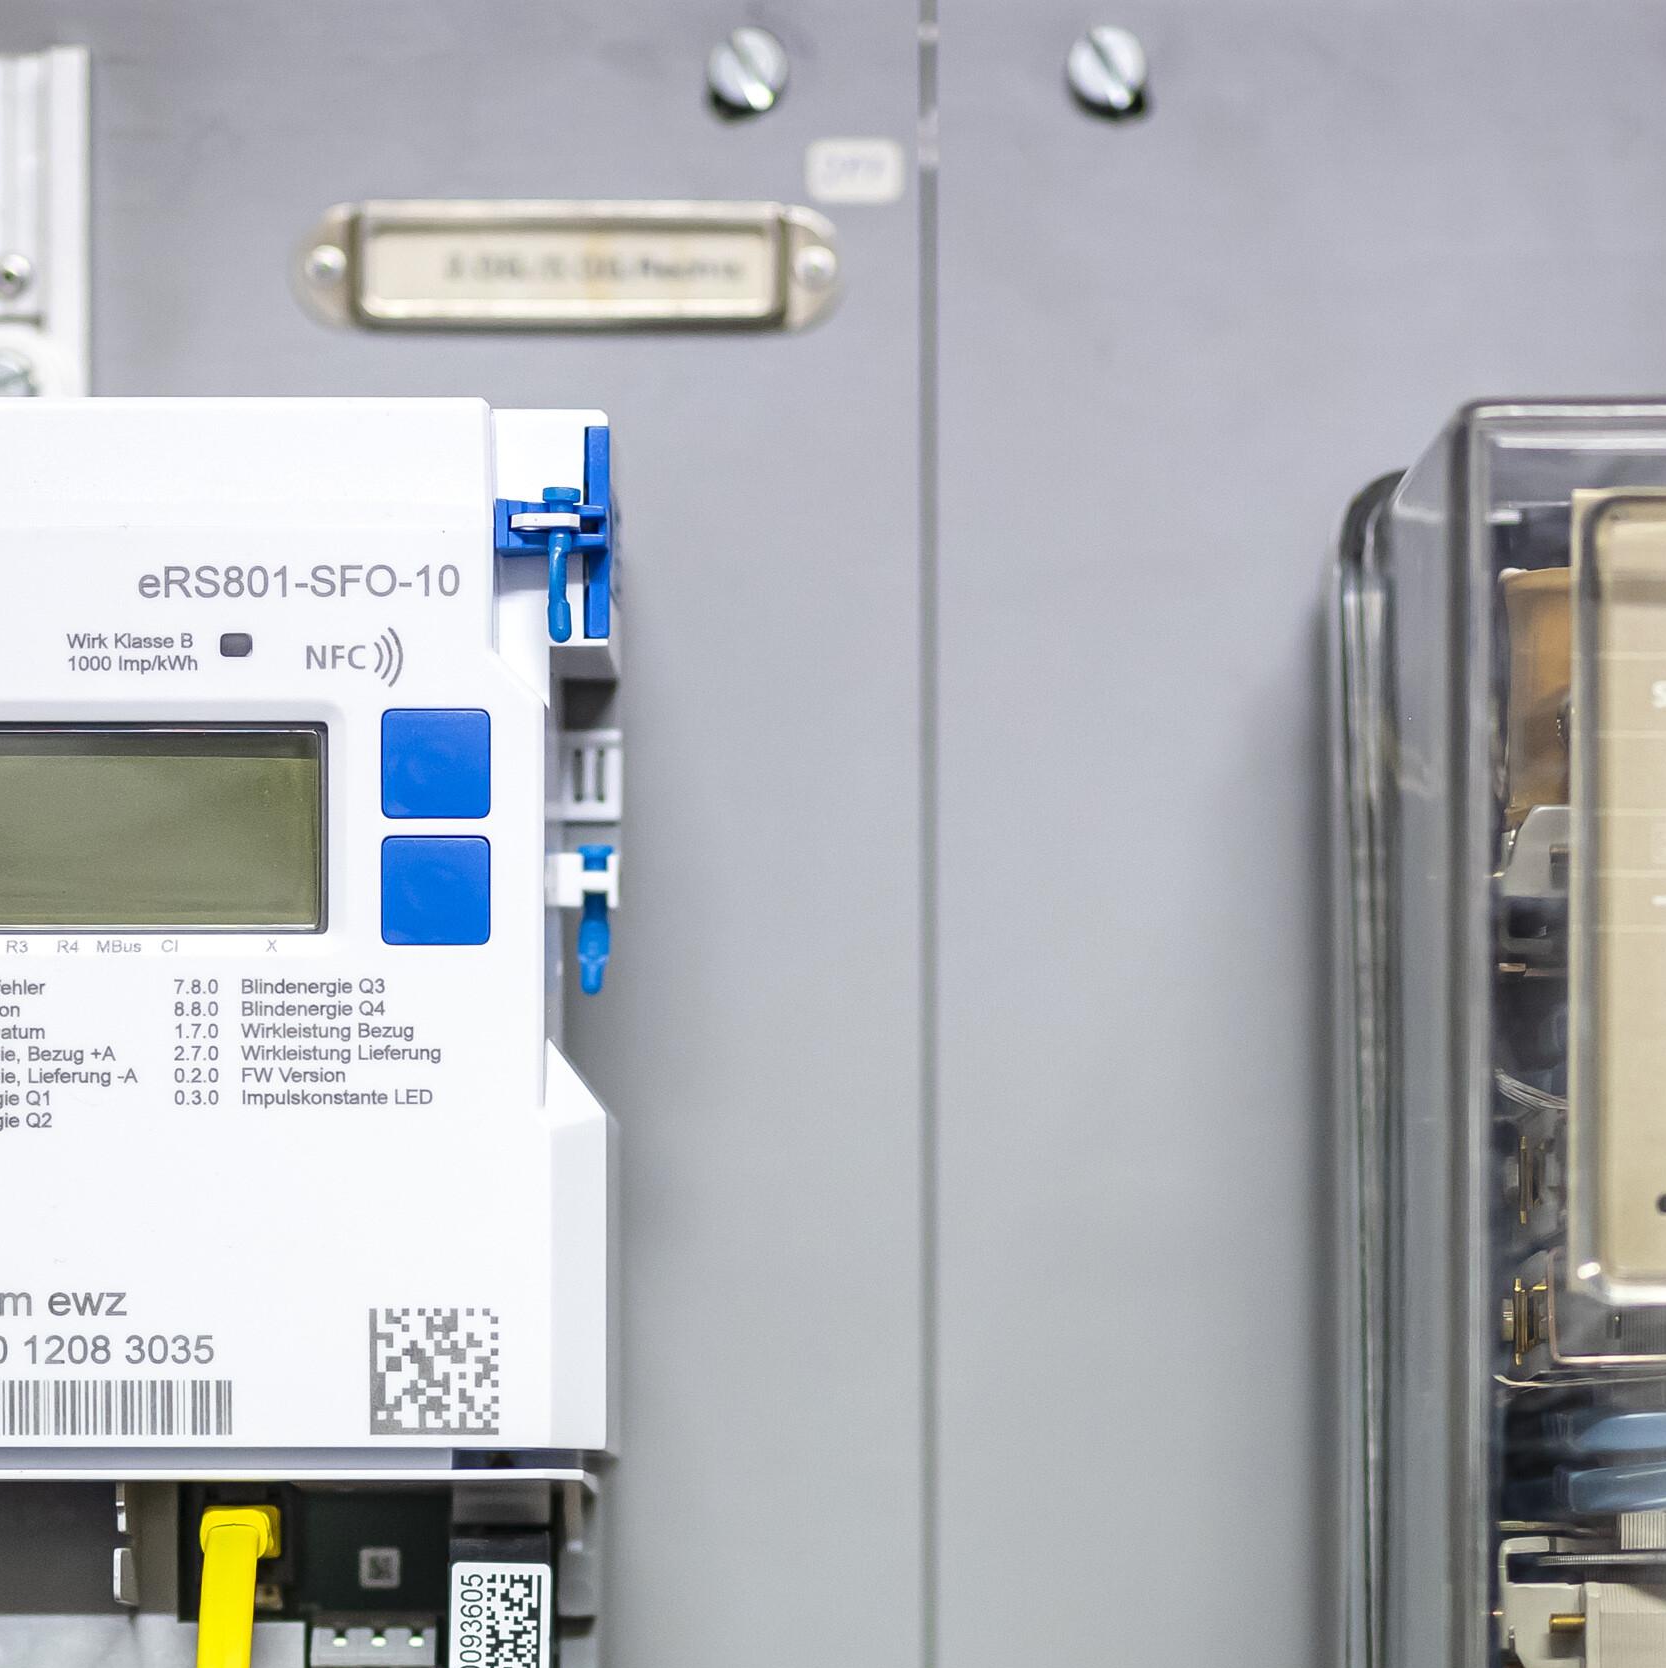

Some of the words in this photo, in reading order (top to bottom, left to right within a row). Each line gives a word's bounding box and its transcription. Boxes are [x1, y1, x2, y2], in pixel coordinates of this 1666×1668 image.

[138, 565, 459, 598] eRS801-SFO-10
[67, 633, 107, 648] Wirk
[115, 633, 174, 648] Klasse
[181, 633, 193, 648] B
[69, 656, 111, 671] 1000
[119, 655, 197, 674] Imp/kWh
[306, 644, 367, 670] NFC
[7, 940, 28, 953] R3
[57, 940, 78, 953] R4
[97, 941, 141, 953] MBus
[266, 940, 277, 952] X
[174, 979, 218, 994] 7.8.0
[242, 978, 352, 997] Blindenergie
[359, 978, 385, 994] Q3
[174, 1001, 218, 1016] 8.8.0
[242, 1001, 353, 1019] Blindenergie
[359, 1000, 385, 1016] Q4
[176, 1023, 218, 1038] 1.7.0
[241, 1023, 351, 1042] Wirkleistung
[358, 1023, 413, 1041] Bezug
[28, 1046, 84, 1065] Bezug
[91, 1046, 116, 1061] +A
[174, 1046, 218, 1061] 2.7.0
[241, 1045, 351, 1064] Wirkleistung
[359, 1045, 441, 1064] Lieferung
[29, 1068, 111, 1087] Lieferung
[117, 1068, 138, 1083] -A
[175, 1068, 218, 1083] 0.2.0
[242, 1068, 273, 1082] FW
[279, 1068, 345, 1082] Version
[26, 1090, 49, 1106] Q1
[175, 1090, 219, 1105] 0.3.0
[243, 1090, 388, 1108] Impulskonstante
[395, 1089, 432, 1104] LED
[26, 1112, 52, 1128] Q2
[48, 1293, 127, 1316] ewz
[24, 1335, 111, 1364] 1208
[125, 1335, 214, 1364] 3035
